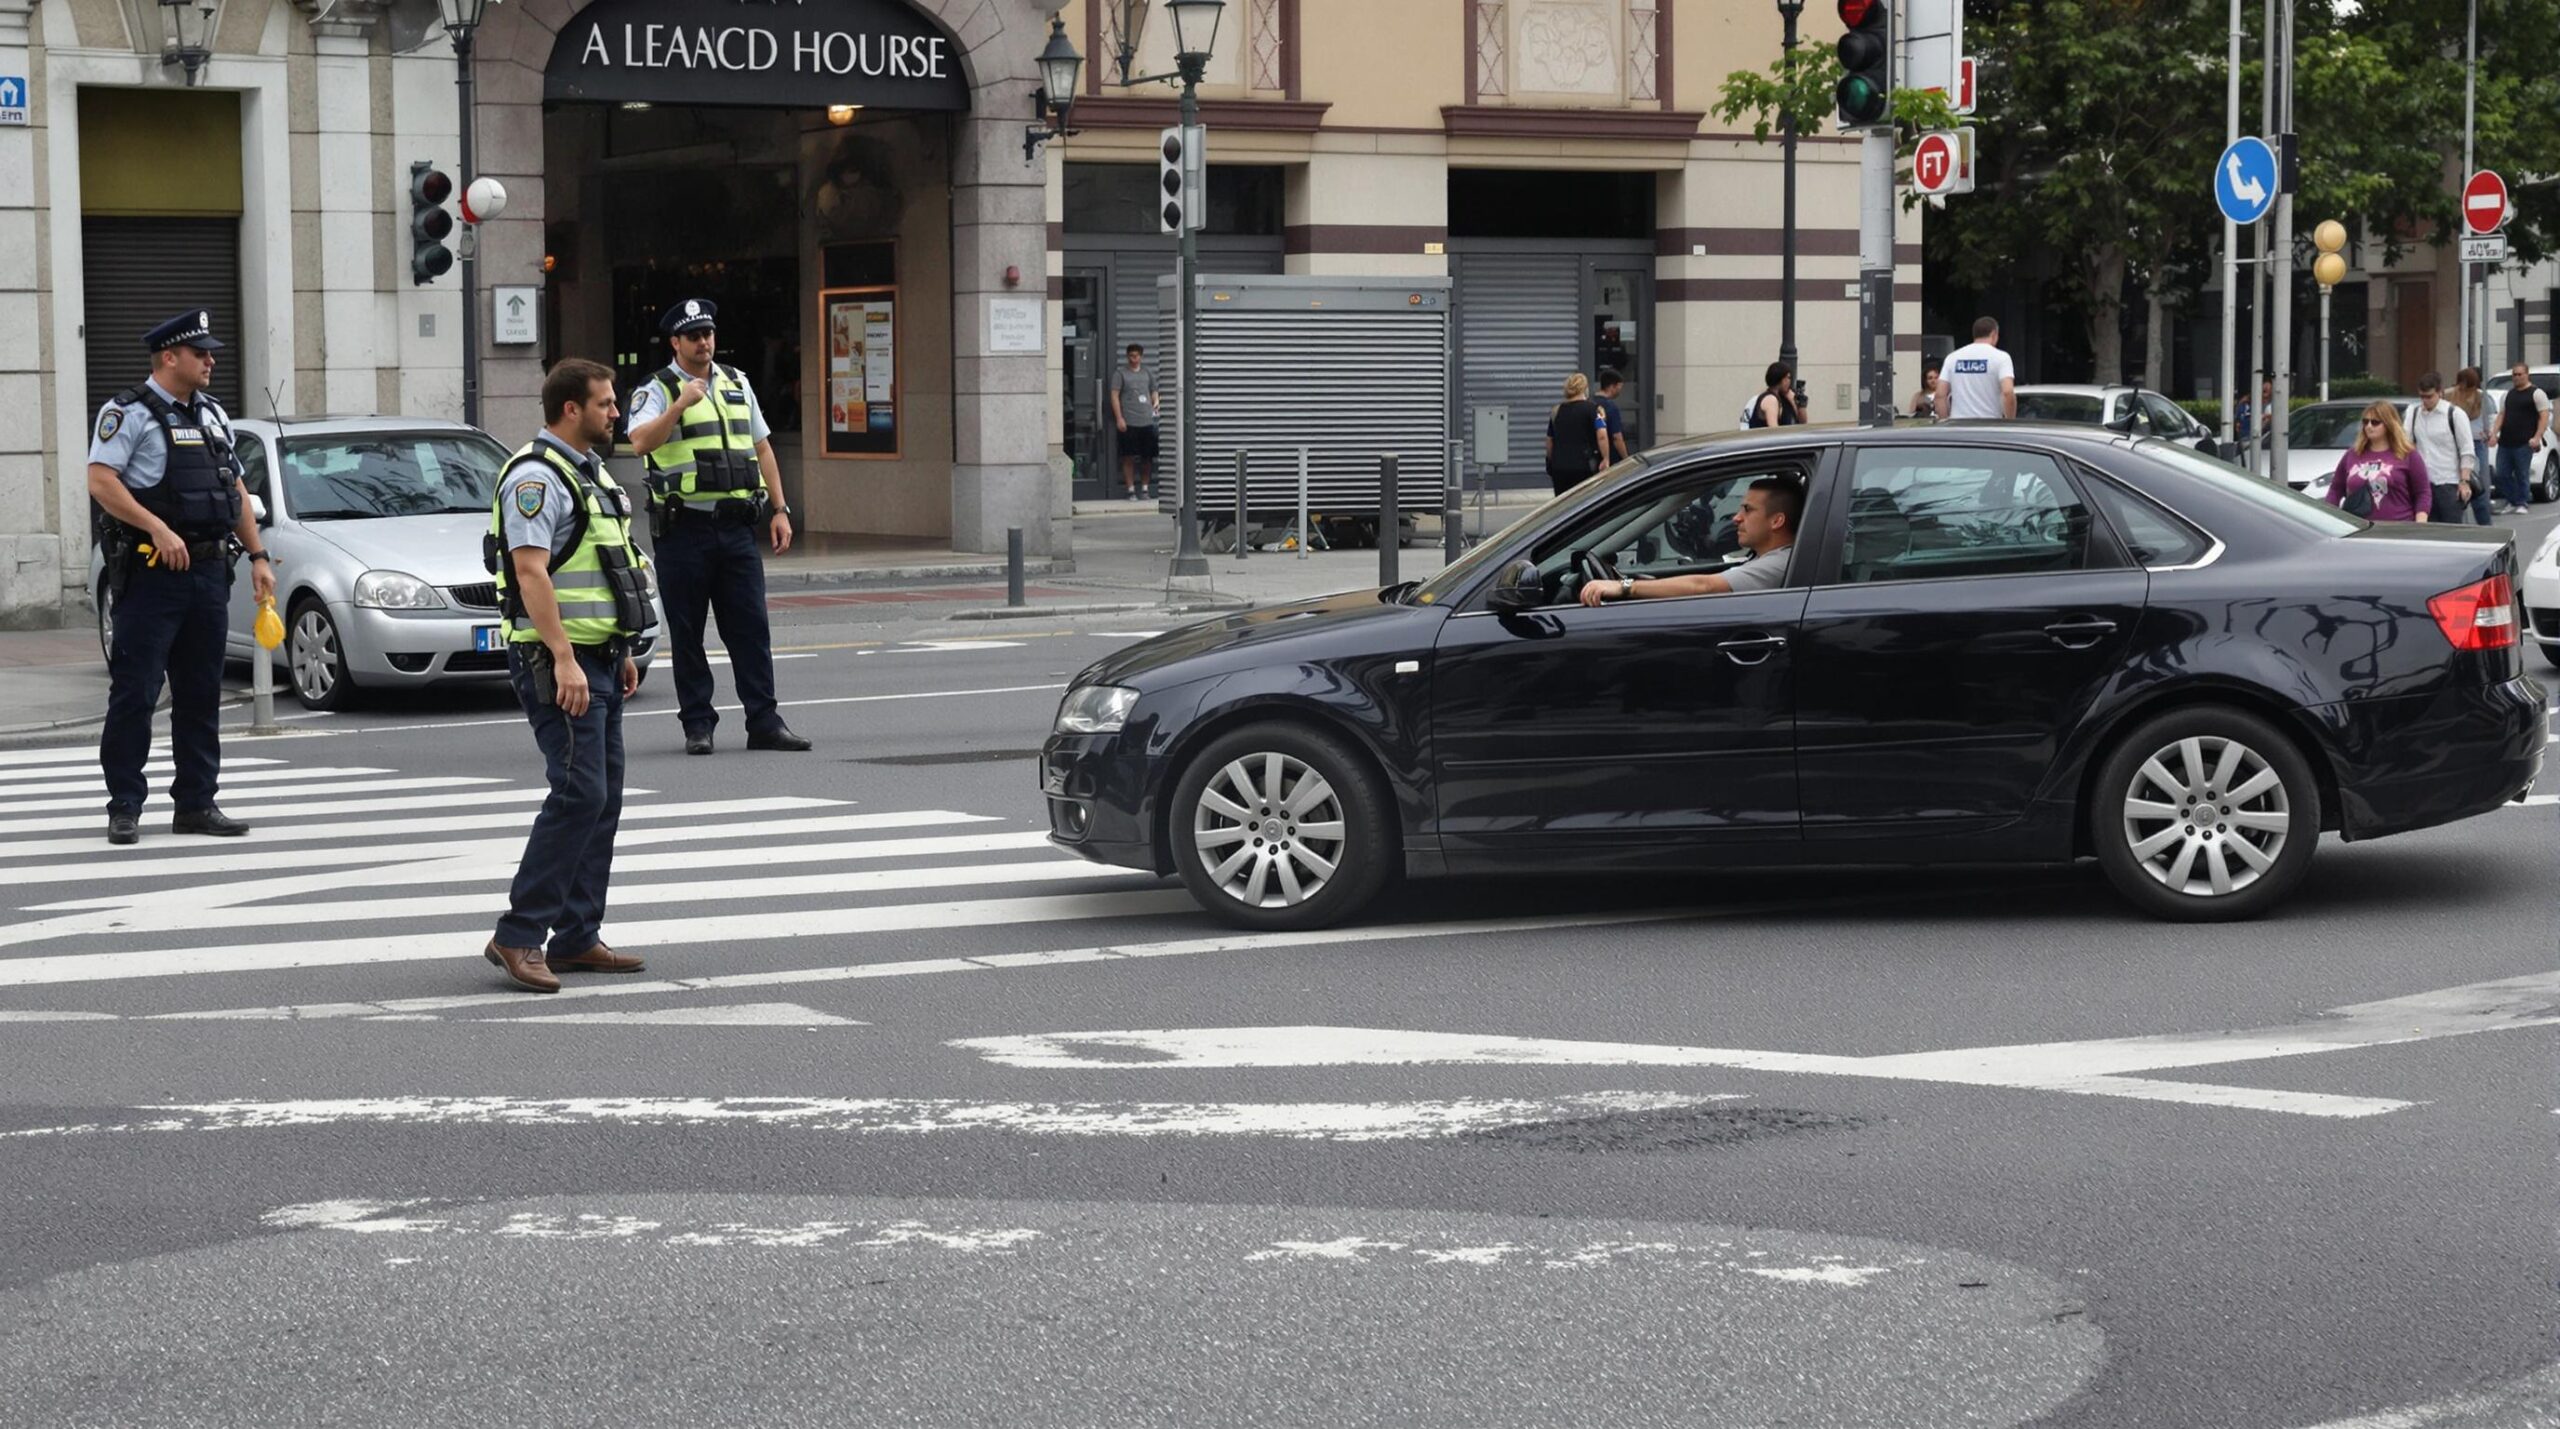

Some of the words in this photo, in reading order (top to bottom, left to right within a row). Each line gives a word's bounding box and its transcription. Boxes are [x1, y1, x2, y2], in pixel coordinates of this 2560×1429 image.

[582, 22, 610, 66] A
[794, 31, 946, 79] HOURSE
[1922, 150, 1945, 179] FT
